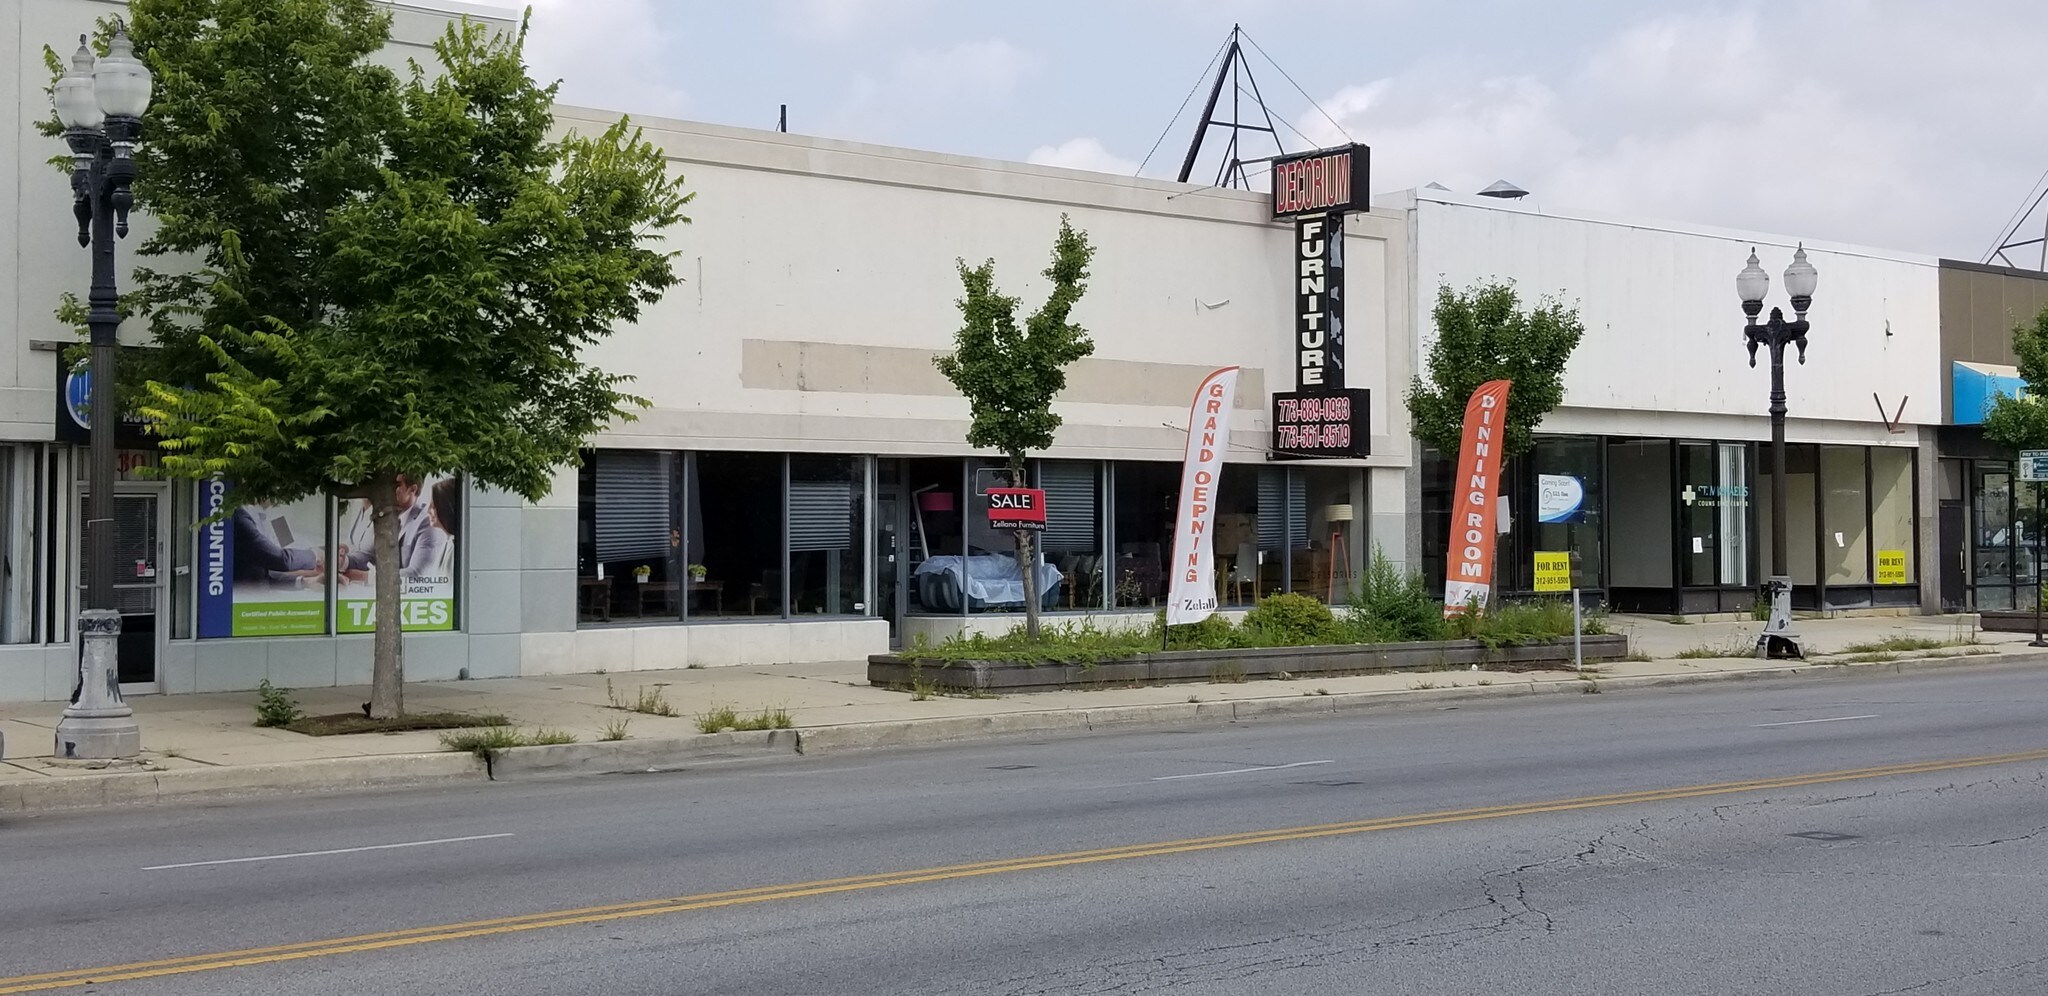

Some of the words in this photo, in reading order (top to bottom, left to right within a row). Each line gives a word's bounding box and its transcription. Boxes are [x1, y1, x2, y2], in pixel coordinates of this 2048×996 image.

[1276, 153, 1351, 214] DECORIUM
[1301, 221, 1324, 385] FURNITURE
[1278, 397, 1350, 423] 773-889-0933
[1199, 384, 1223, 463] GRAND
[1278, 424, 1350, 448] 773-561-8519
[1469, 394, 1496, 506] DINNING
[991, 494, 1031, 509] SALE
[992, 520, 1018, 528] Zellano
[1018, 520, 1045, 529] Furniture
[1185, 470, 1212, 583] OEPNING
[1460, 512, 1483, 577] ROOM
[1536, 561, 1551, 571] FOR
[1552, 561, 1568, 571] RENT
[408, 576, 449, 584] ENROLLED
[408, 586, 434, 594] AGENT
